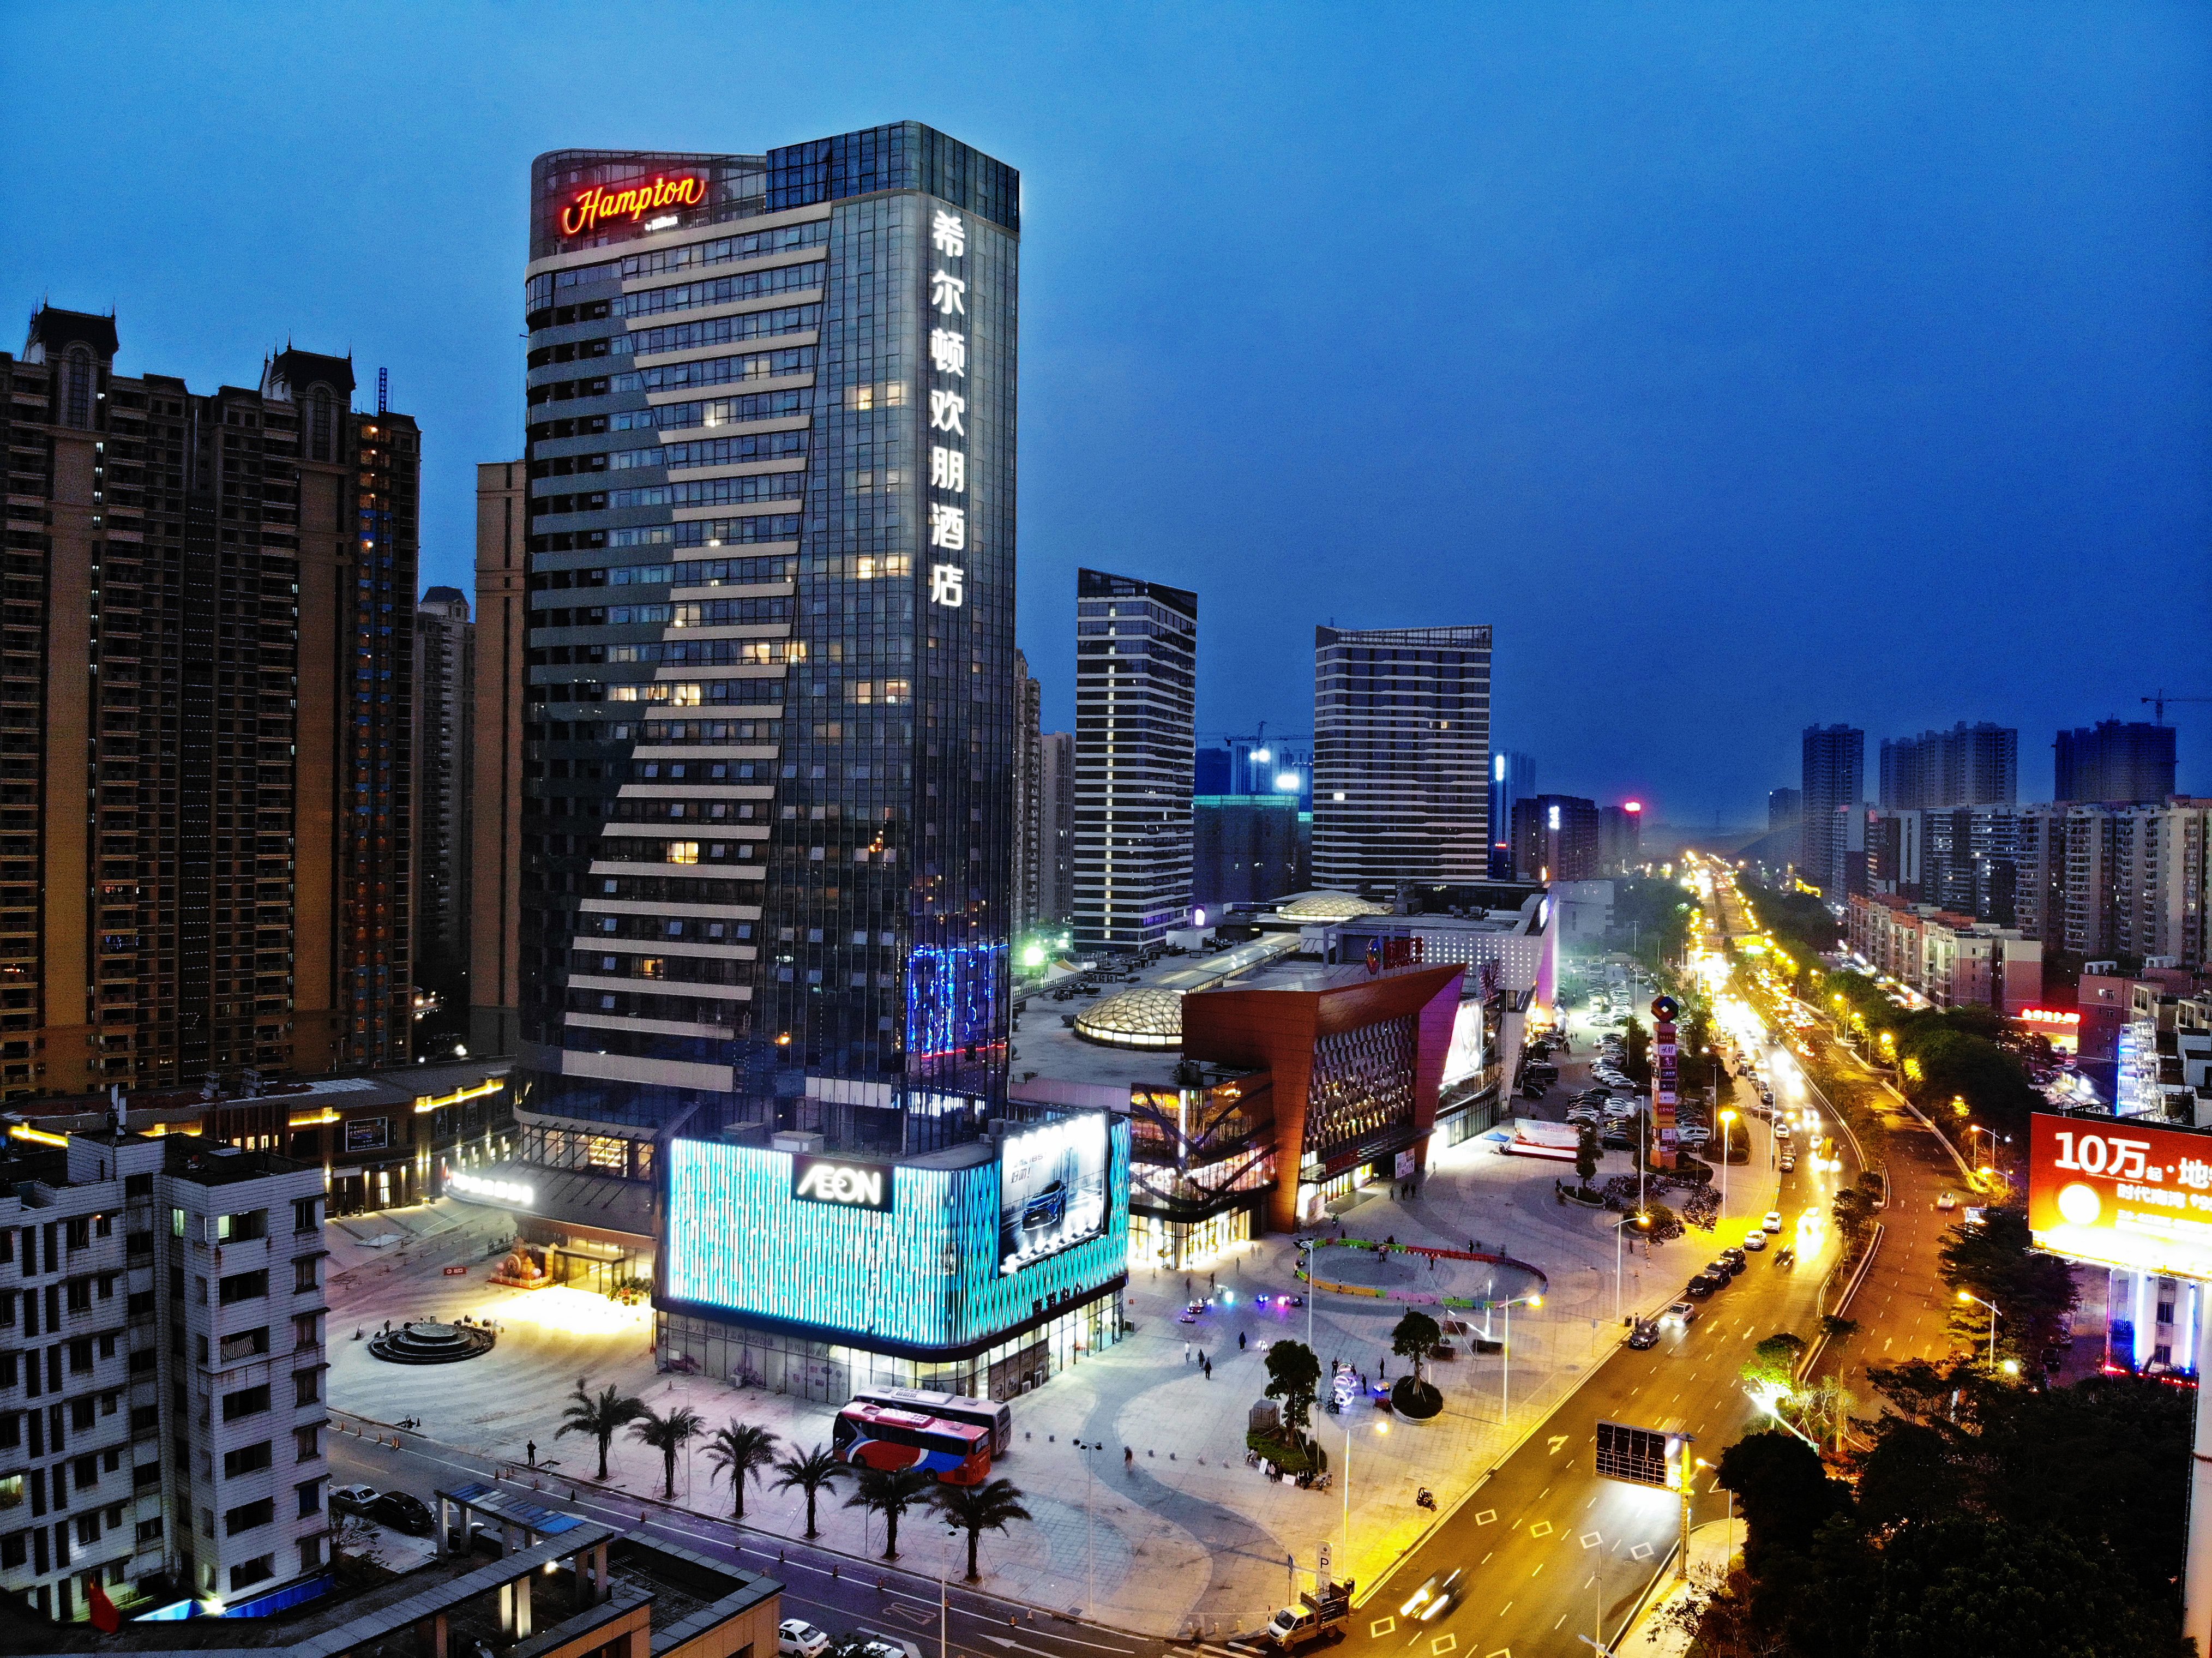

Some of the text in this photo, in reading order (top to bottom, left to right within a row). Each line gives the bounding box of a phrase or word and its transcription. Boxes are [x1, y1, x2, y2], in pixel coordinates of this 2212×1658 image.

[563, 177, 705, 235] Hampton
[652, 216, 678, 230] Hilton
[930, 209, 965, 608] 希尔顿欢朋酒店
[2055, 1132, 2212, 1189] 10万起·地
[1320, 1557, 1329, 1569] P
